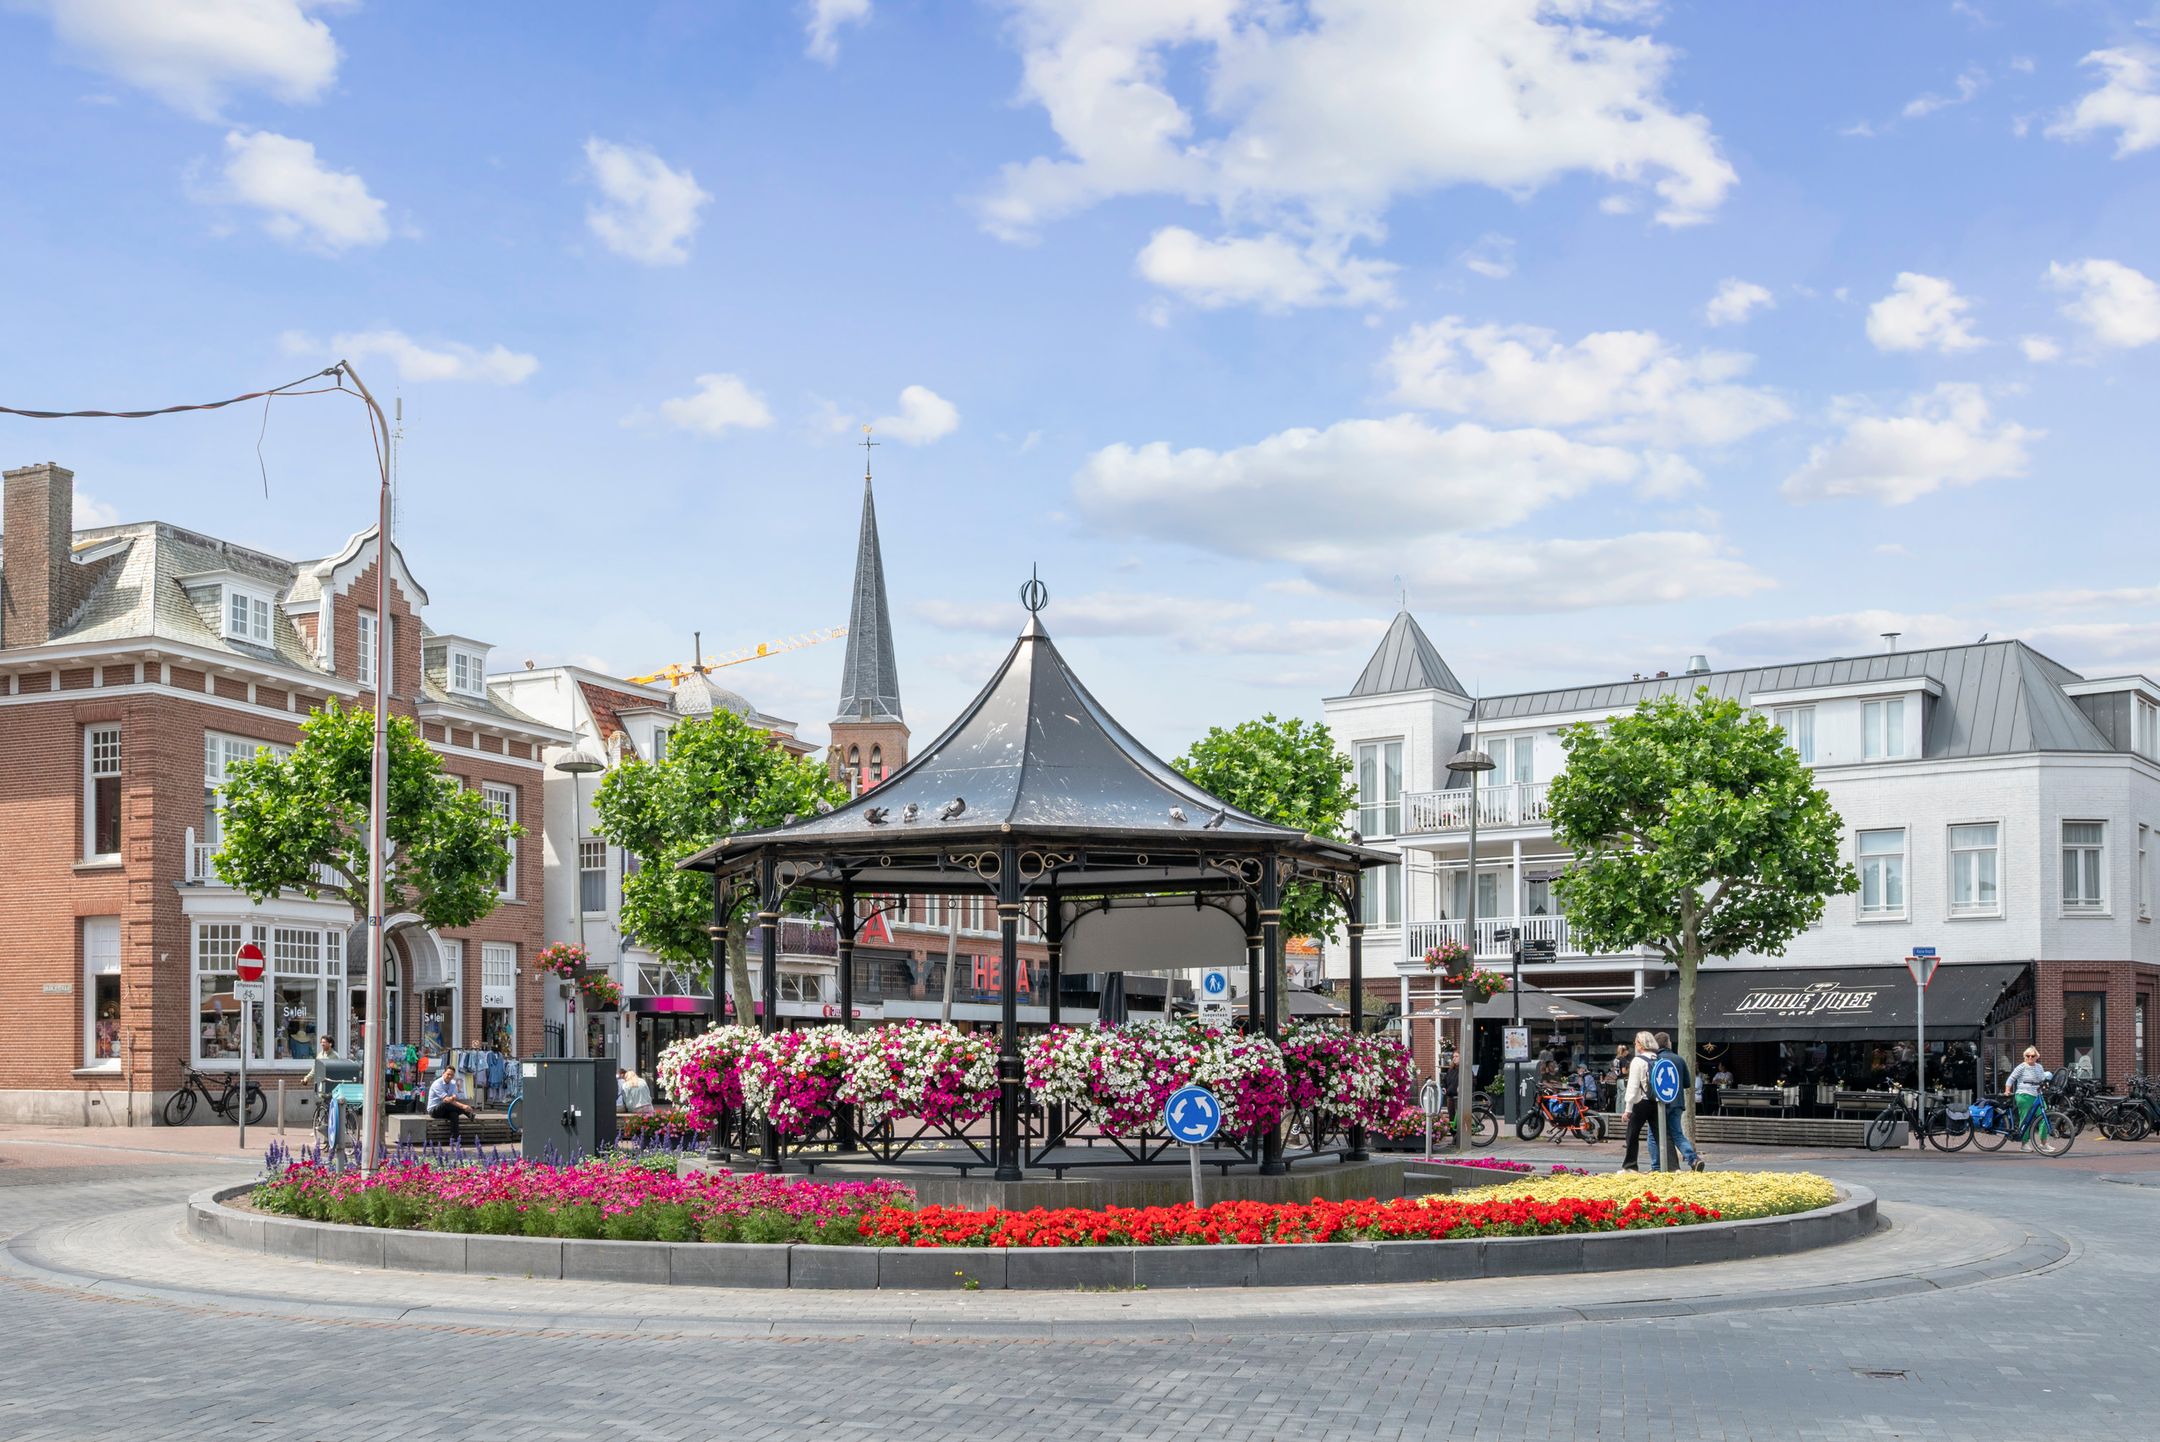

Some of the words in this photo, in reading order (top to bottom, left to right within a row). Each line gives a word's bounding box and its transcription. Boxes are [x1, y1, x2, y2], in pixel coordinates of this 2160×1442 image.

[972, 955, 1030, 992] HEA
[1736, 993, 1815, 1011] NOBLE
[1812, 992, 1877, 1010] TREE
